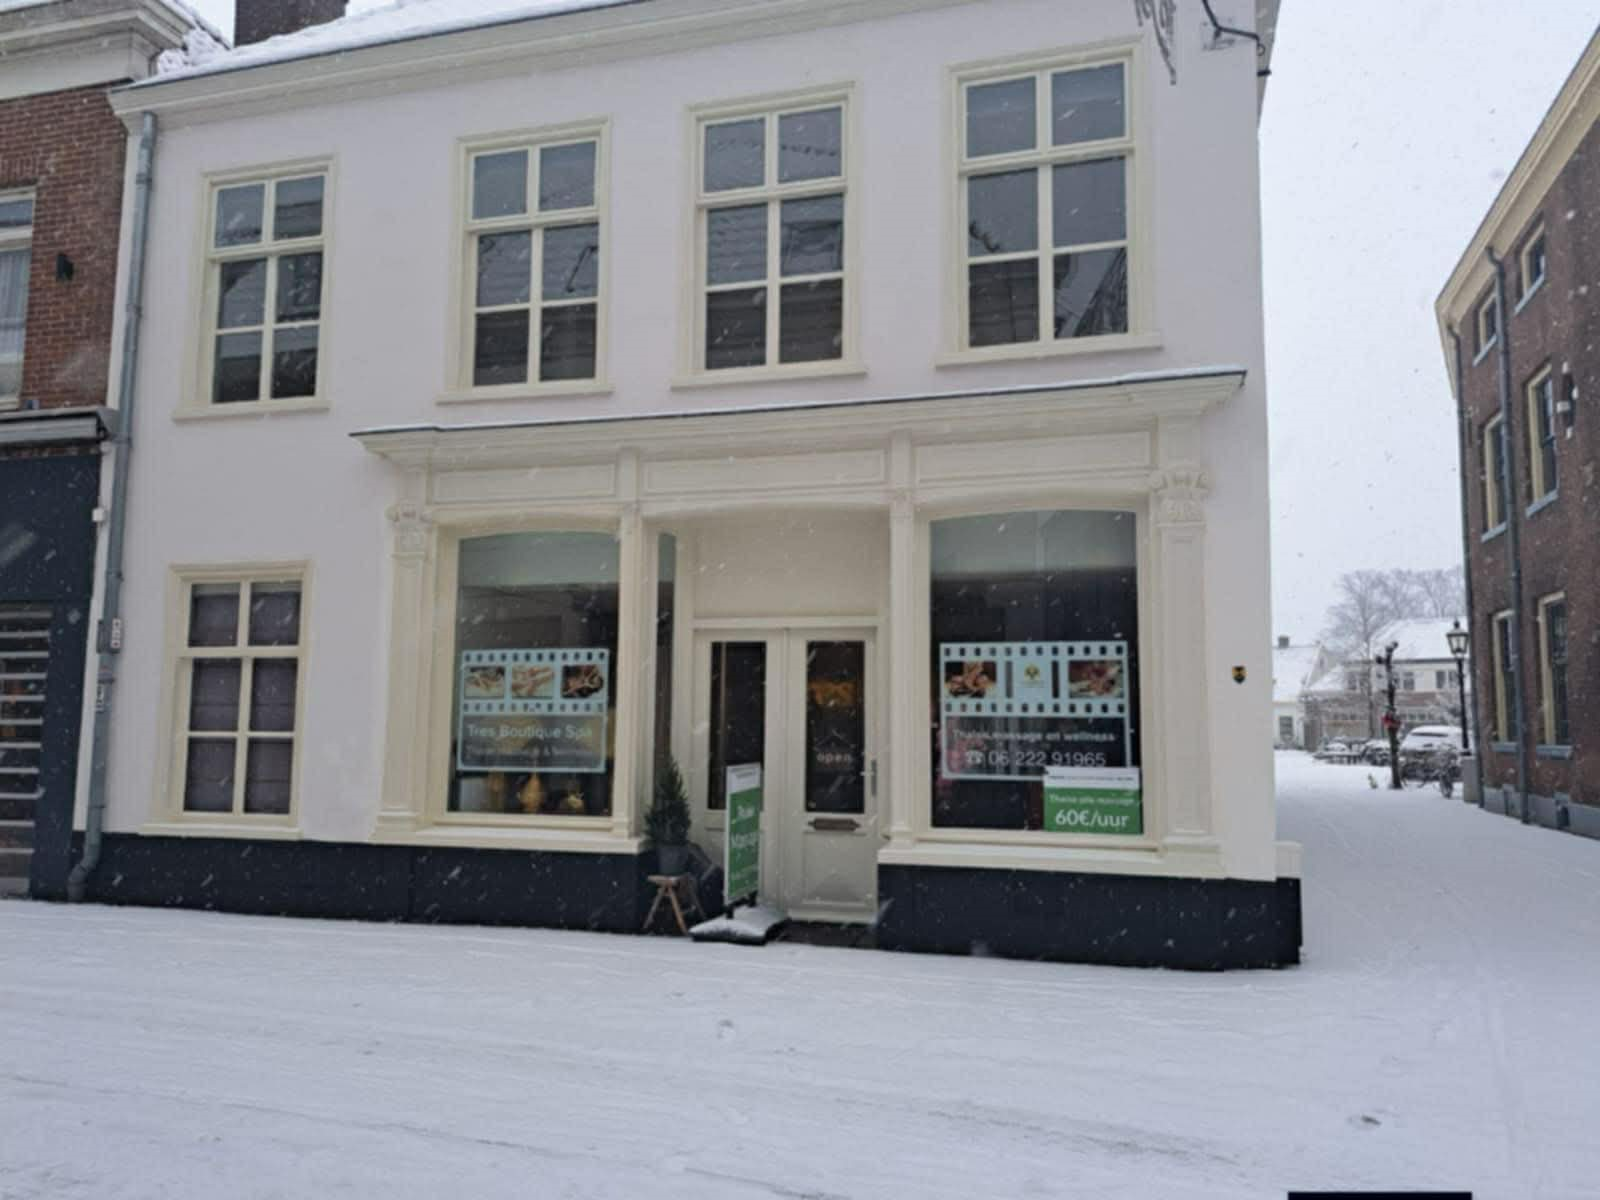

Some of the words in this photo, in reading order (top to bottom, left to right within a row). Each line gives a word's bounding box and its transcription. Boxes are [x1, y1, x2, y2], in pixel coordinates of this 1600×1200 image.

[467, 724, 496, 737] Tres
[499, 724, 561, 740] Boutique
[565, 724, 592, 740] Spa
[816, 753, 850, 764] open
[989, 751, 1009, 766] 06
[1015, 751, 1046, 767] 222
[1051, 752, 1106, 767] 91965
[1055, 809, 1130, 827] 60€/uur
